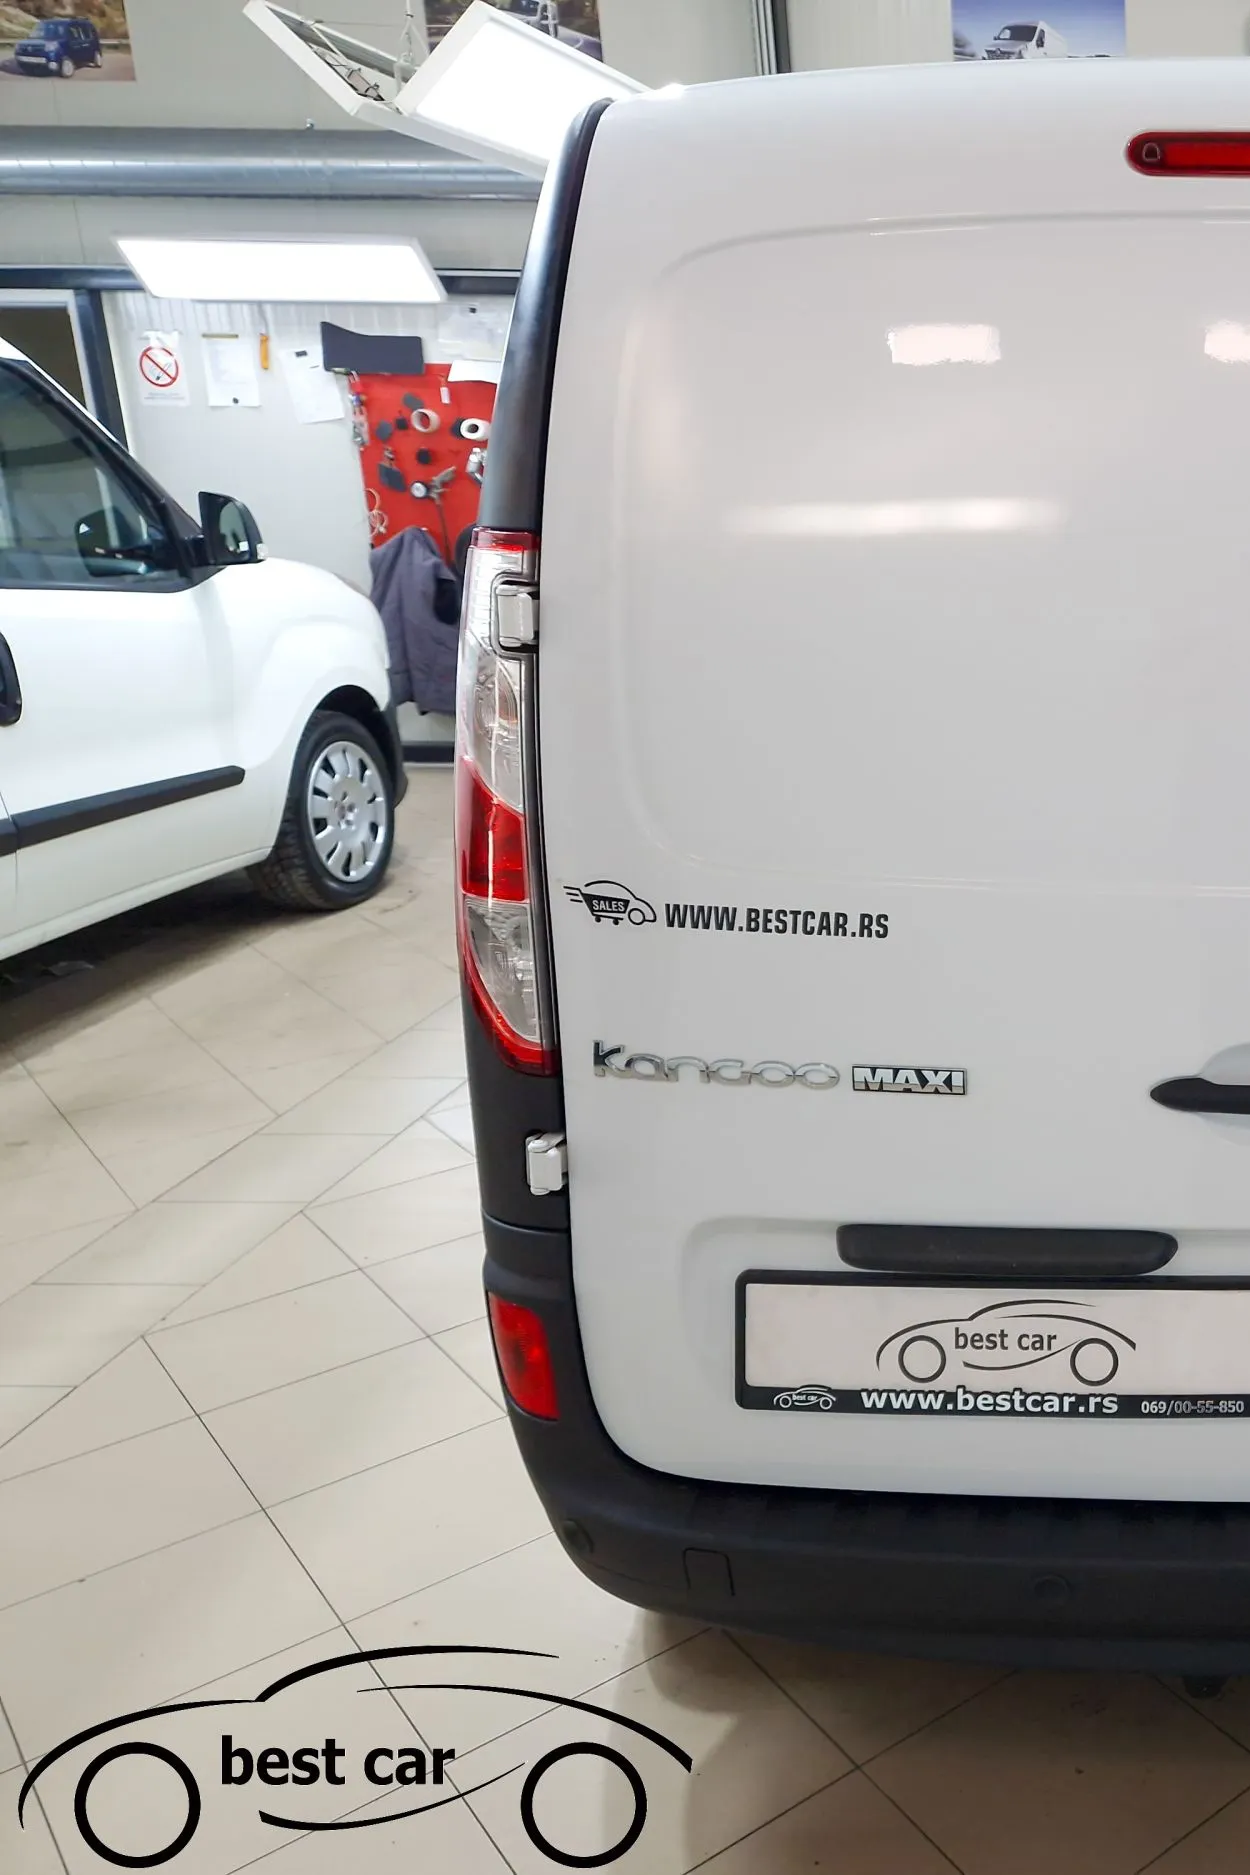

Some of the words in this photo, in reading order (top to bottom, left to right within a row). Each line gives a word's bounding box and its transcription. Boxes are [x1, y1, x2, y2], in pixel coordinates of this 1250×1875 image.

[592, 899, 626, 913] SALES
[664, 903, 890, 939] WWW.BESTCAR.RS
[853, 1067, 965, 1094] MAXI
[954, 1327, 1009, 1351] best
[1017, 1332, 1057, 1352] car
[860, 1387, 1119, 1414] www.bestcar.rs
[1141, 1400, 1245, 1416] 069/00-55-850
